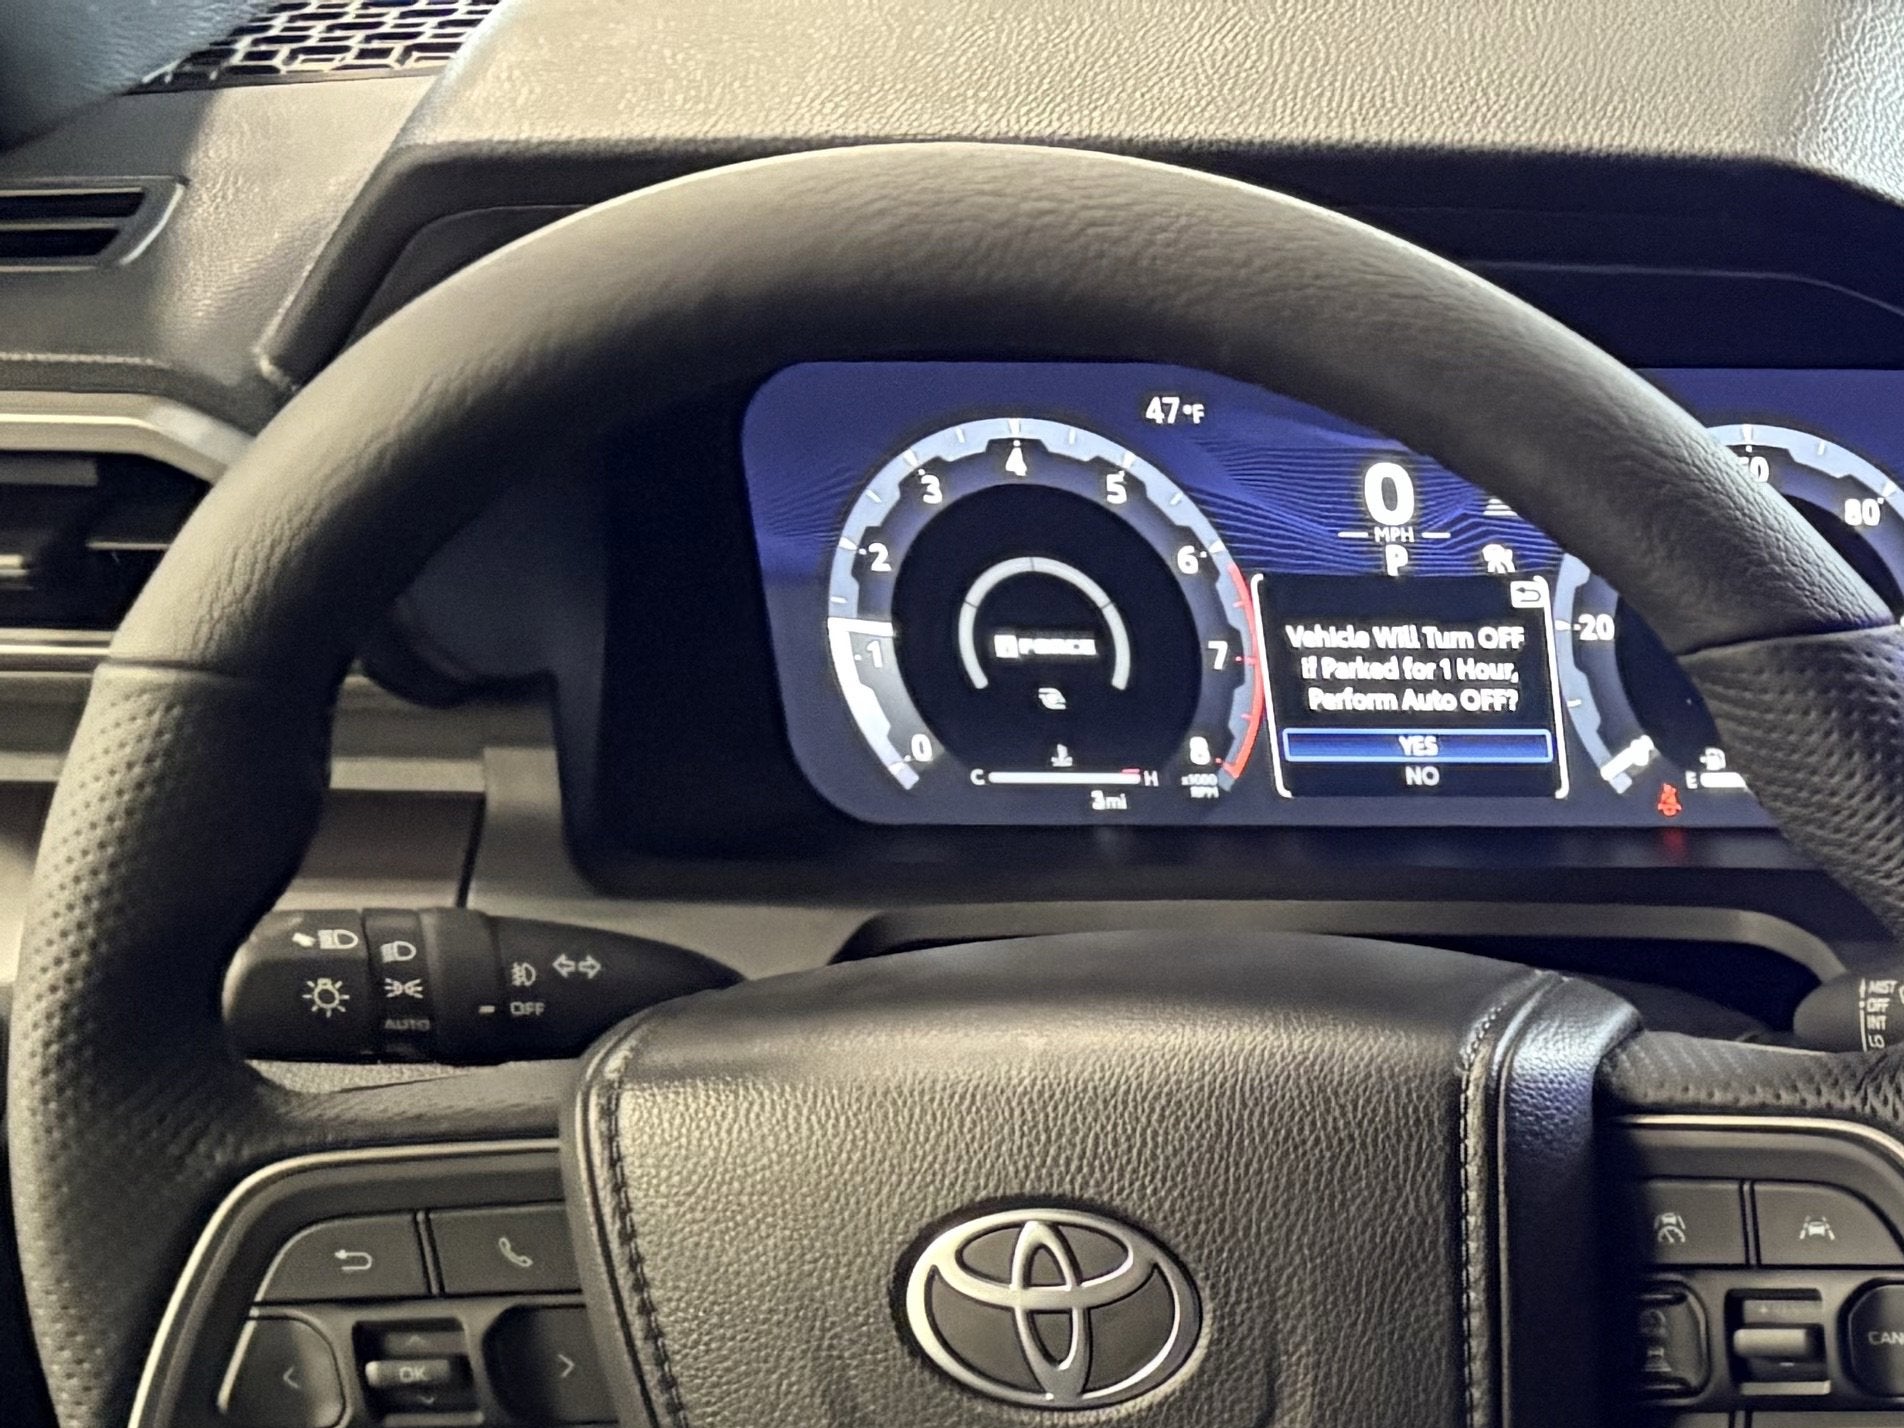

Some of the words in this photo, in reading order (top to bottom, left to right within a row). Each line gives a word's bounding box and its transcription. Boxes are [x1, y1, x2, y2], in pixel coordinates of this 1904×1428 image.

[921, 474, 943, 504] 3
[1106, 474, 1127, 504] 5
[1364, 462, 1414, 525] 0
[1844, 500, 1881, 526] 80
[1374, 526, 1415, 543] MPH
[868, 543, 892, 571] 2
[1177, 546, 1199, 574] 6
[1386, 544, 1408, 577] P
[1285, 624, 1370, 648] Vehicle
[1372, 624, 1421, 649] Will
[1422, 626, 1475, 649] Turn
[1477, 627, 1525, 649] OFF
[1579, 614, 1615, 641] 20
[867, 641, 883, 668] 1
[1208, 641, 1228, 669] 7
[1301, 656, 1318, 679] If
[1322, 656, 1400, 680] Parked
[1403, 657, 1437, 681] for
[1439, 658, 1452, 680] 1
[1456, 658, 1519, 683] Hour,
[1308, 687, 1398, 711] Perform
[1402, 688, 1458, 711] Auto
[1460, 688, 1519, 712] OFF?
[911, 734, 933, 762] 0
[1189, 736, 1211, 765] 8
[1399, 736, 1438, 757] YES
[970, 769, 985, 786] C
[1144, 770, 1159, 787] H
[1405, 766, 1440, 786] NO
[1686, 771, 1697, 789] E
[510, 1001, 545, 1016] OFF
[384, 1019, 430, 1032] AUTO
[1866, 1014, 1887, 1031] INT
[399, 1366, 428, 1382] OK
